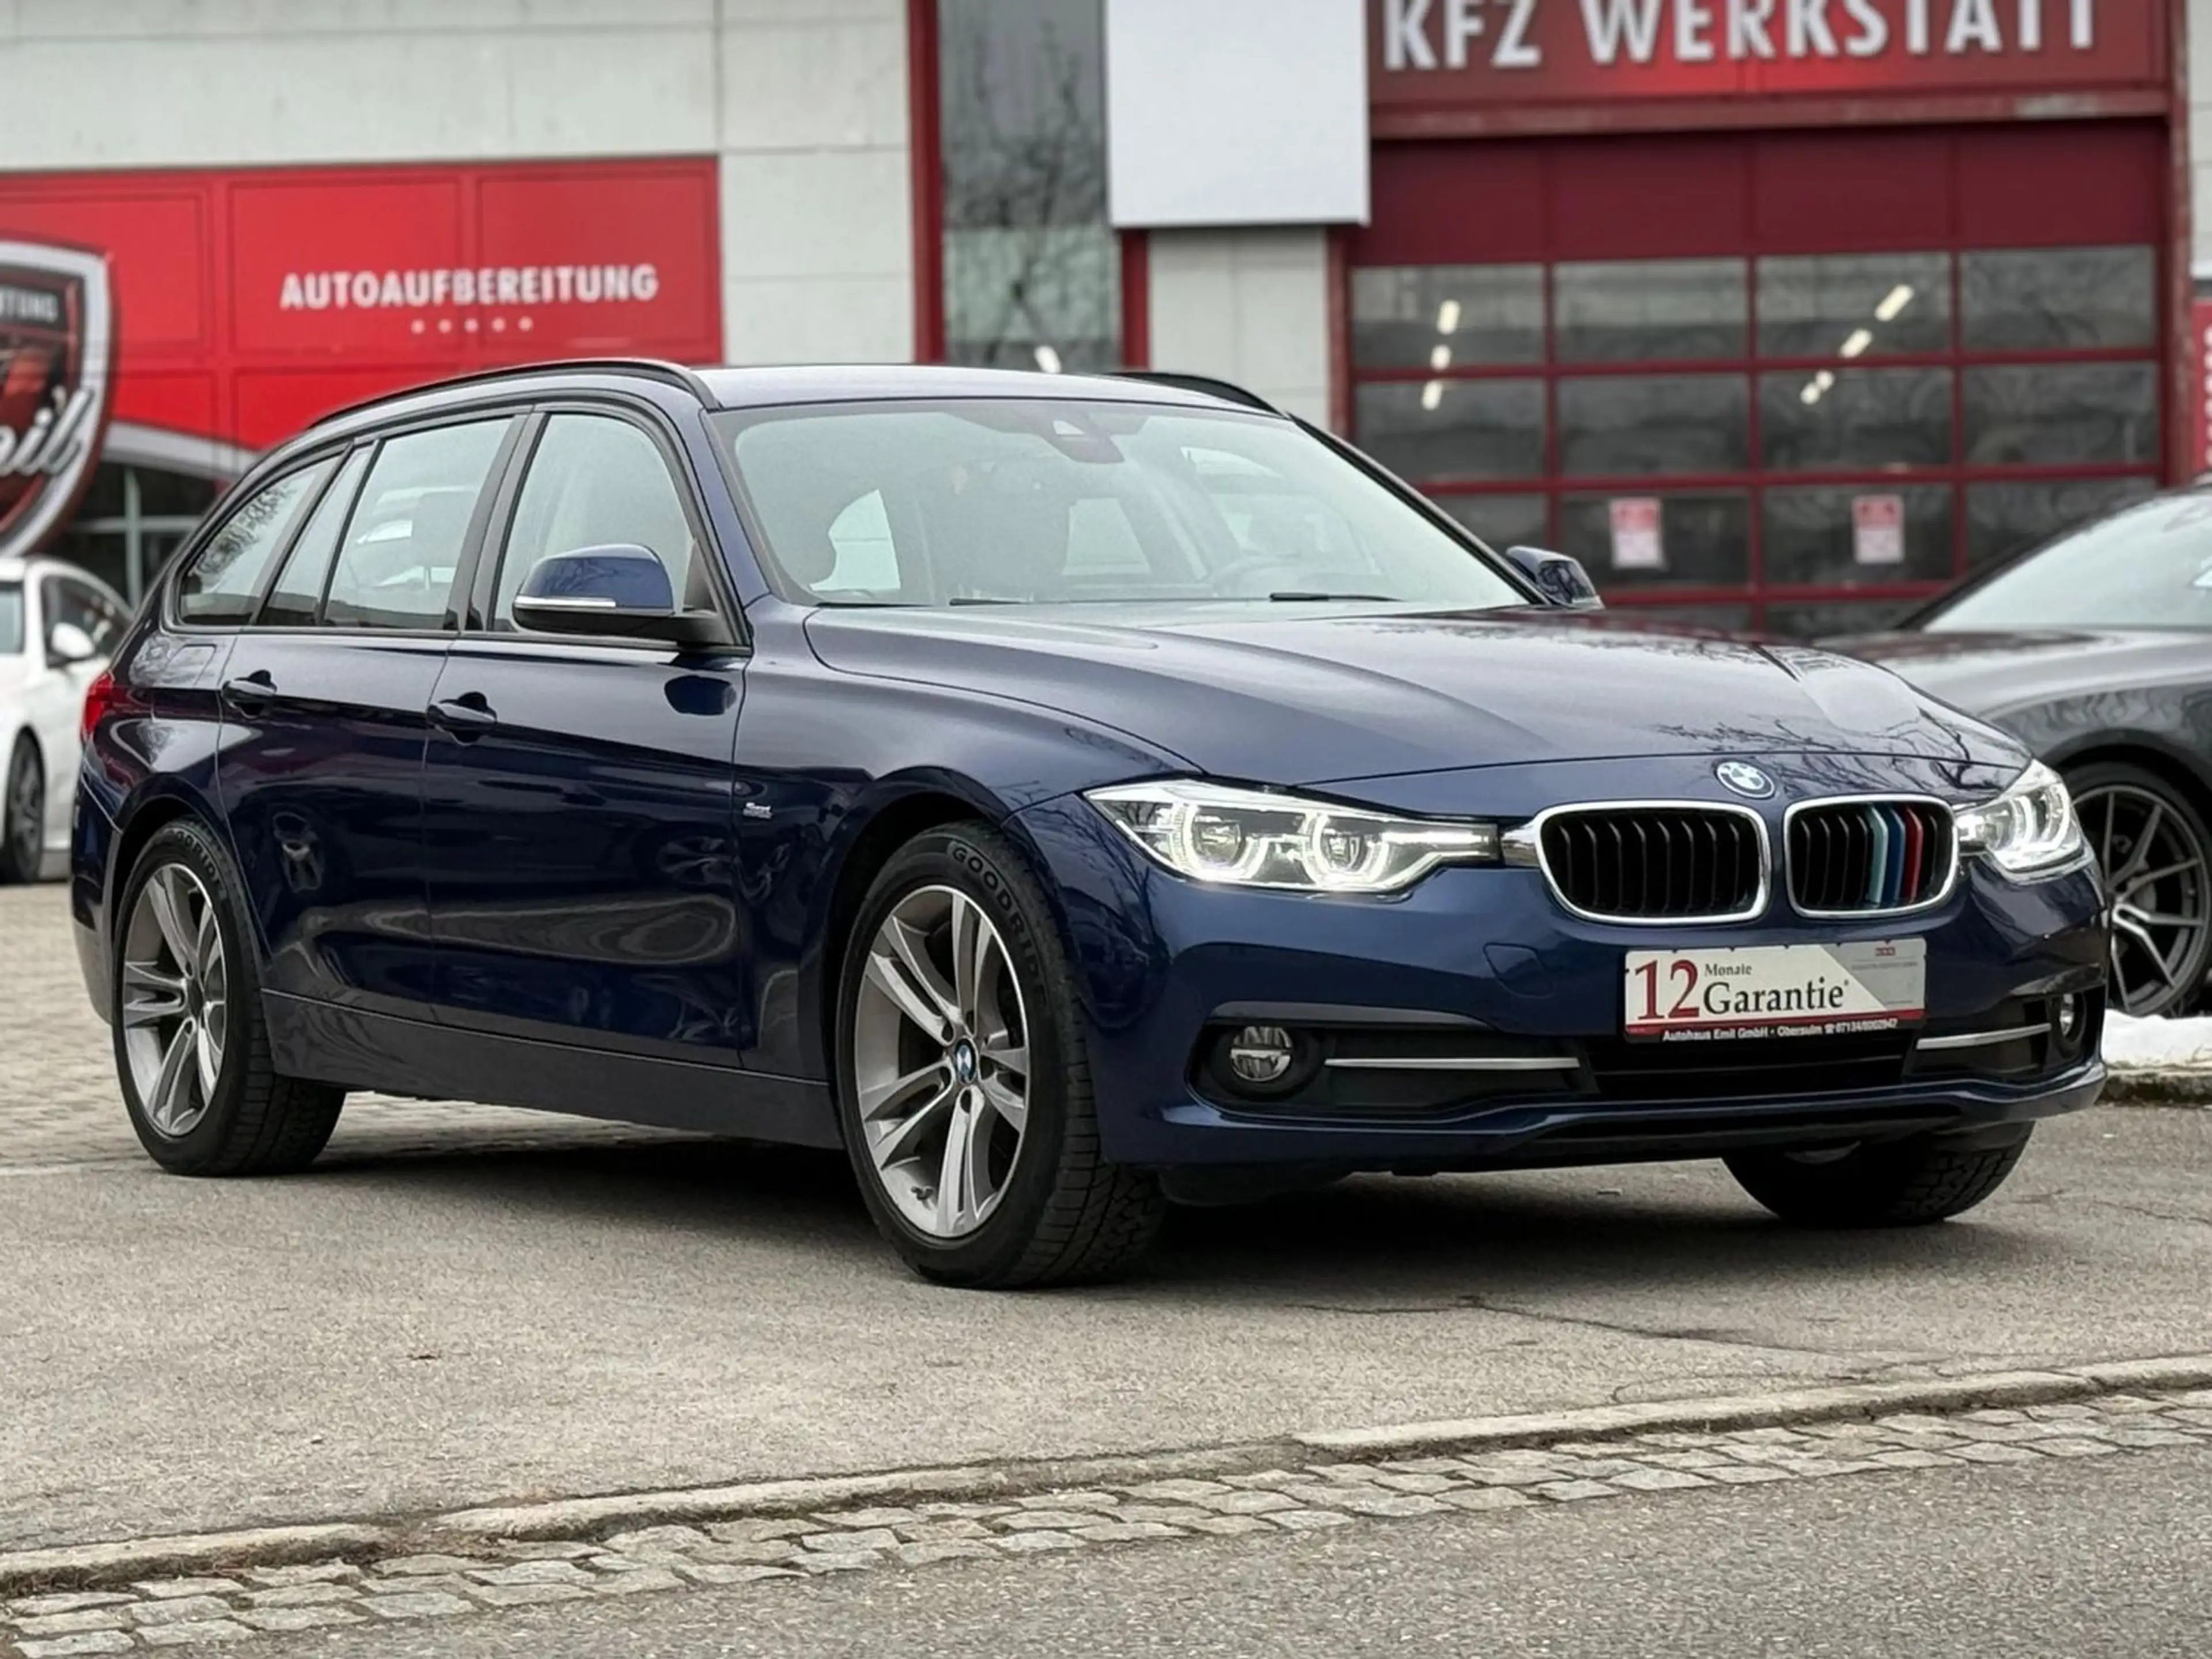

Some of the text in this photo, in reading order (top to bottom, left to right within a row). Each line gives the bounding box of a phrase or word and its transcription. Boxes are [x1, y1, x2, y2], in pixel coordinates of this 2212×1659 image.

[1384, 0, 1541, 70] KFZ
[279, 263, 658, 310] AUTOAUFBEREITUNG
[1635, 959, 1700, 1020] 12
[1703, 976, 1844, 1015] Garantie
